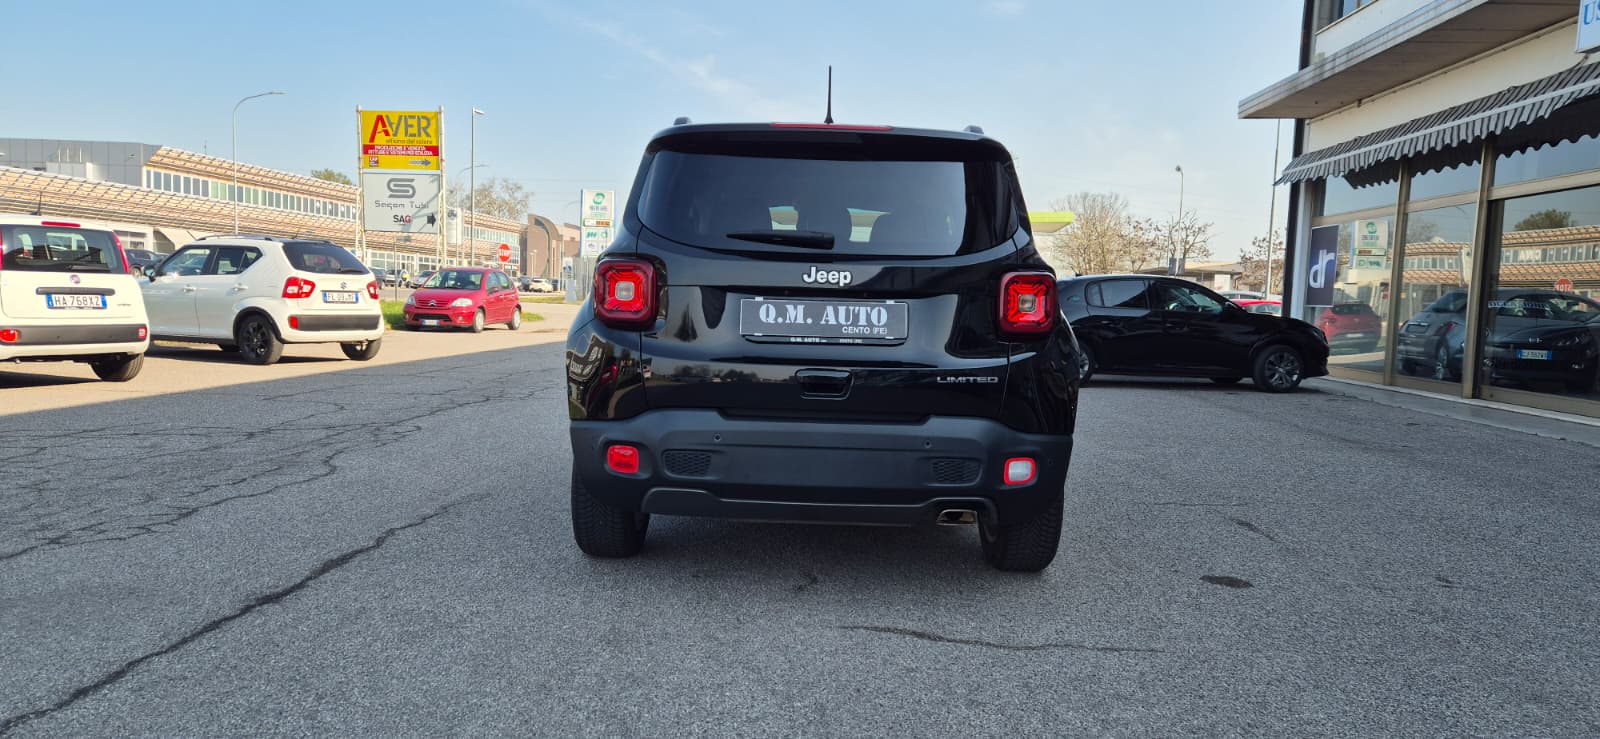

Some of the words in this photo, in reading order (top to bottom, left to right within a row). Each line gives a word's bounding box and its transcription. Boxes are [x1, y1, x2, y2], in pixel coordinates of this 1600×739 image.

[369, 114, 432, 143] AVER
[803, 266, 851, 286] Jeep
[1309, 249, 1335, 288] dr
[759, 303, 813, 324] Q.M.
[820, 305, 888, 326] AUTO
[841, 326, 871, 334] CENTO
[872, 327, 888, 335] (FE)
